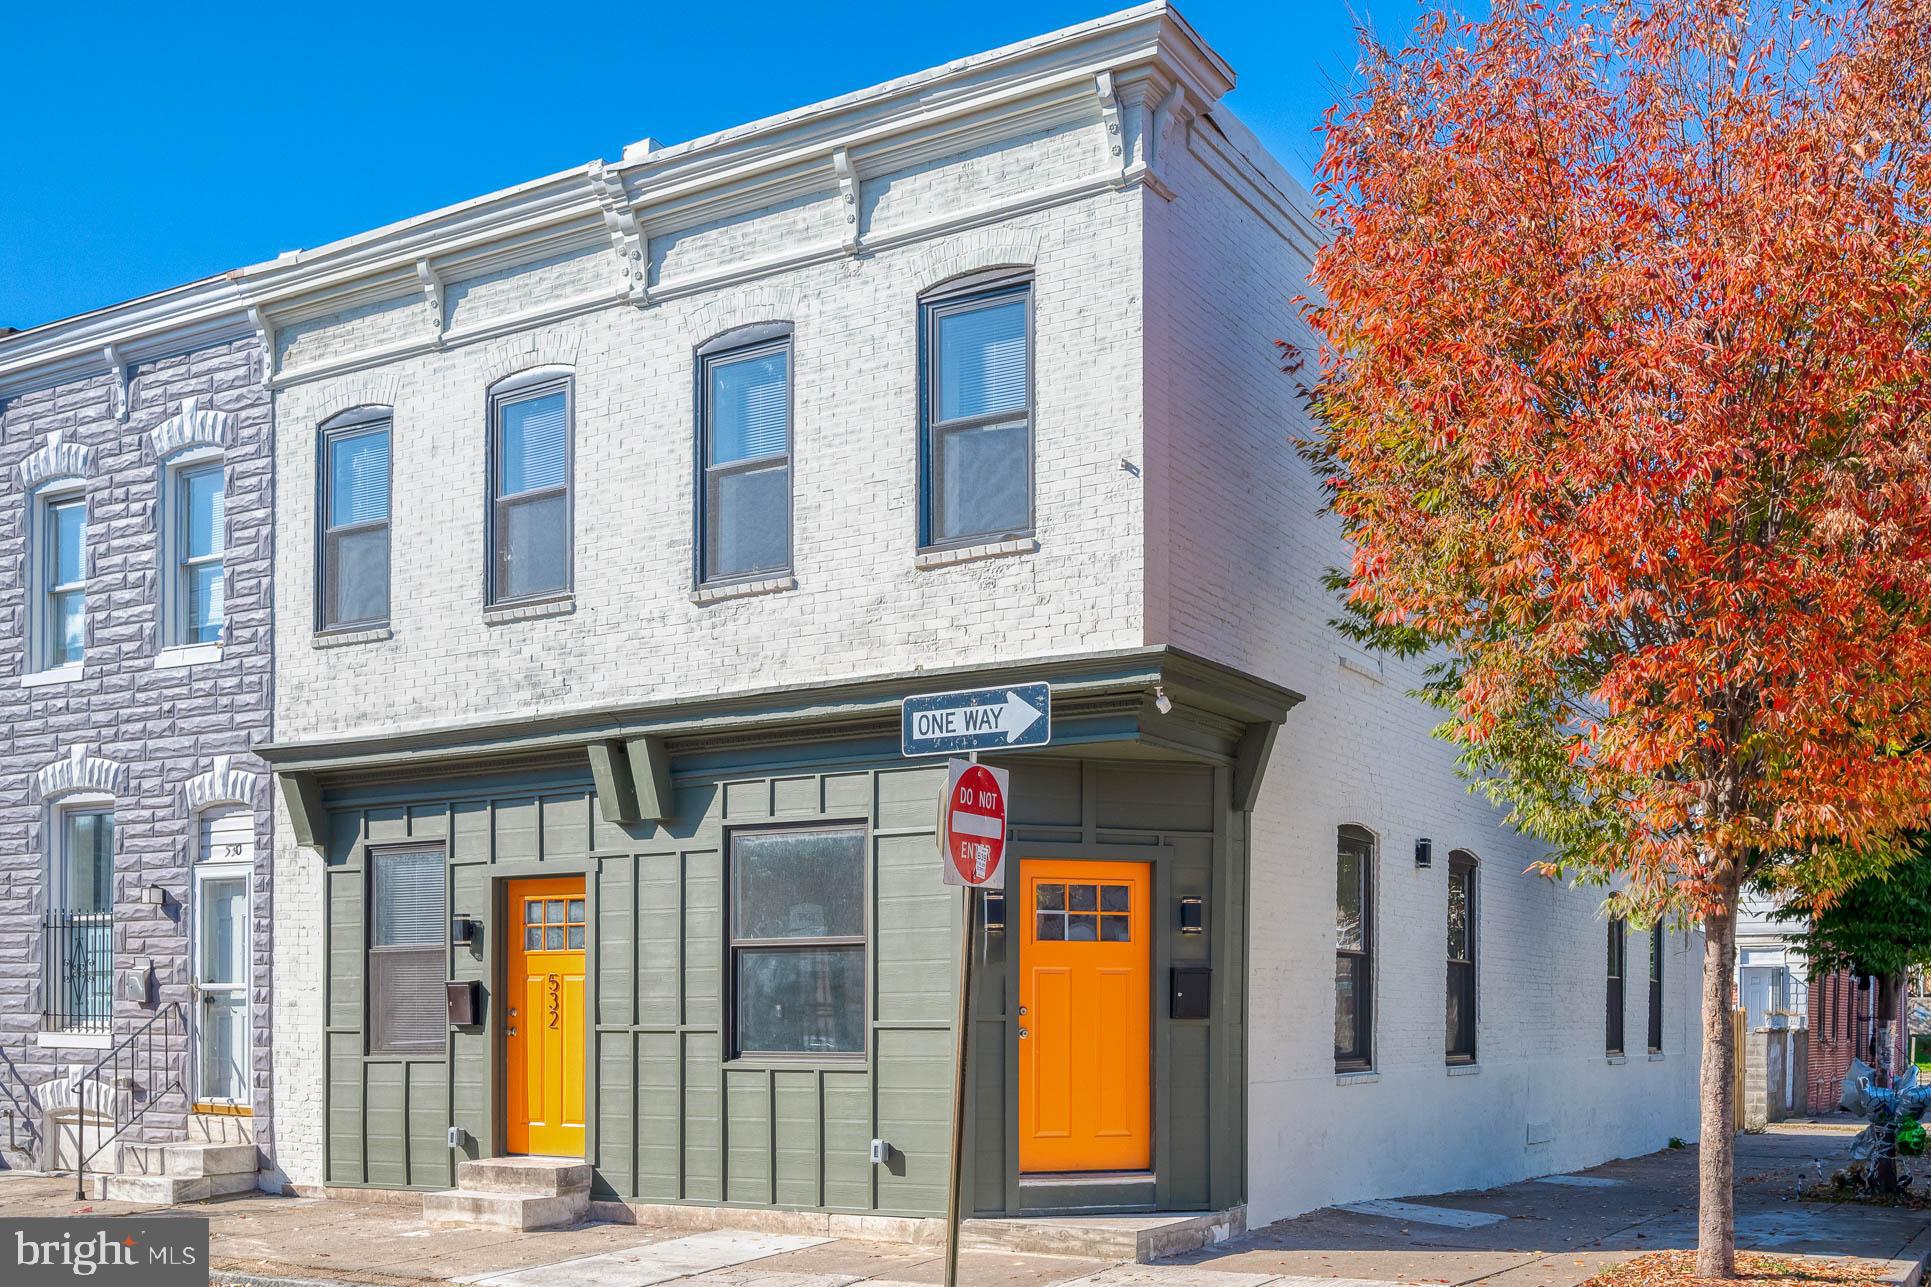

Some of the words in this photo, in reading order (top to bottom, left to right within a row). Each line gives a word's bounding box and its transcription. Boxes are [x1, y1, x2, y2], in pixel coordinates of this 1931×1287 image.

[918, 711, 956, 736] ONE
[964, 706, 1004, 732] WAY
[960, 787, 973, 806] DO
[979, 791, 997, 810] NOT
[548, 973, 560, 1030] 532
